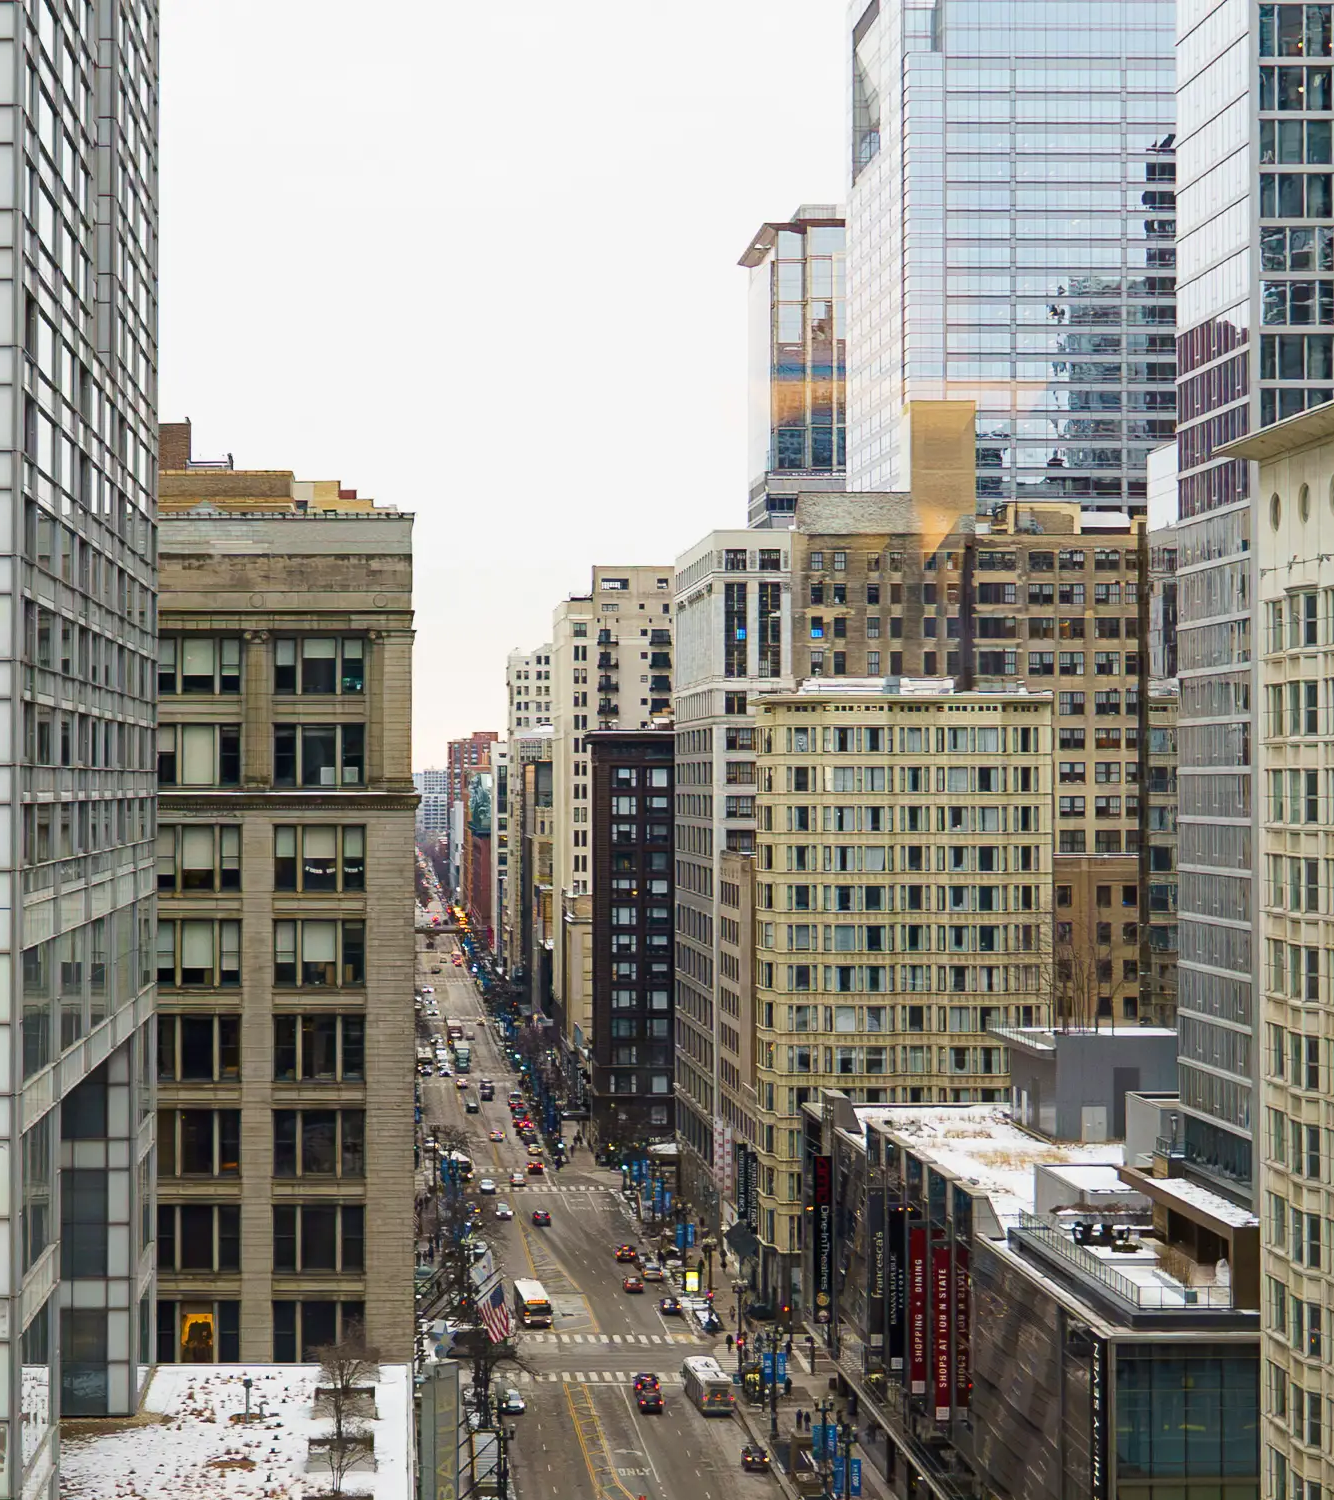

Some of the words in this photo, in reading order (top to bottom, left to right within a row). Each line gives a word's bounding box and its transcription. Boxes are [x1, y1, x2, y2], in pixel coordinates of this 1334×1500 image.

[750, 1207, 758, 1228] rack
[870, 1231, 884, 1299] francesca's
[914, 1259, 923, 1293] DINING
[938, 1268, 947, 1299] STATE
[914, 1313, 923, 1362] SHOPPING
[938, 1314, 947, 1333] 108
[938, 1339, 947, 1351] AT
[938, 1355, 947, 1388] SHOPS
[618, 1467, 651, 1476] ONLY
